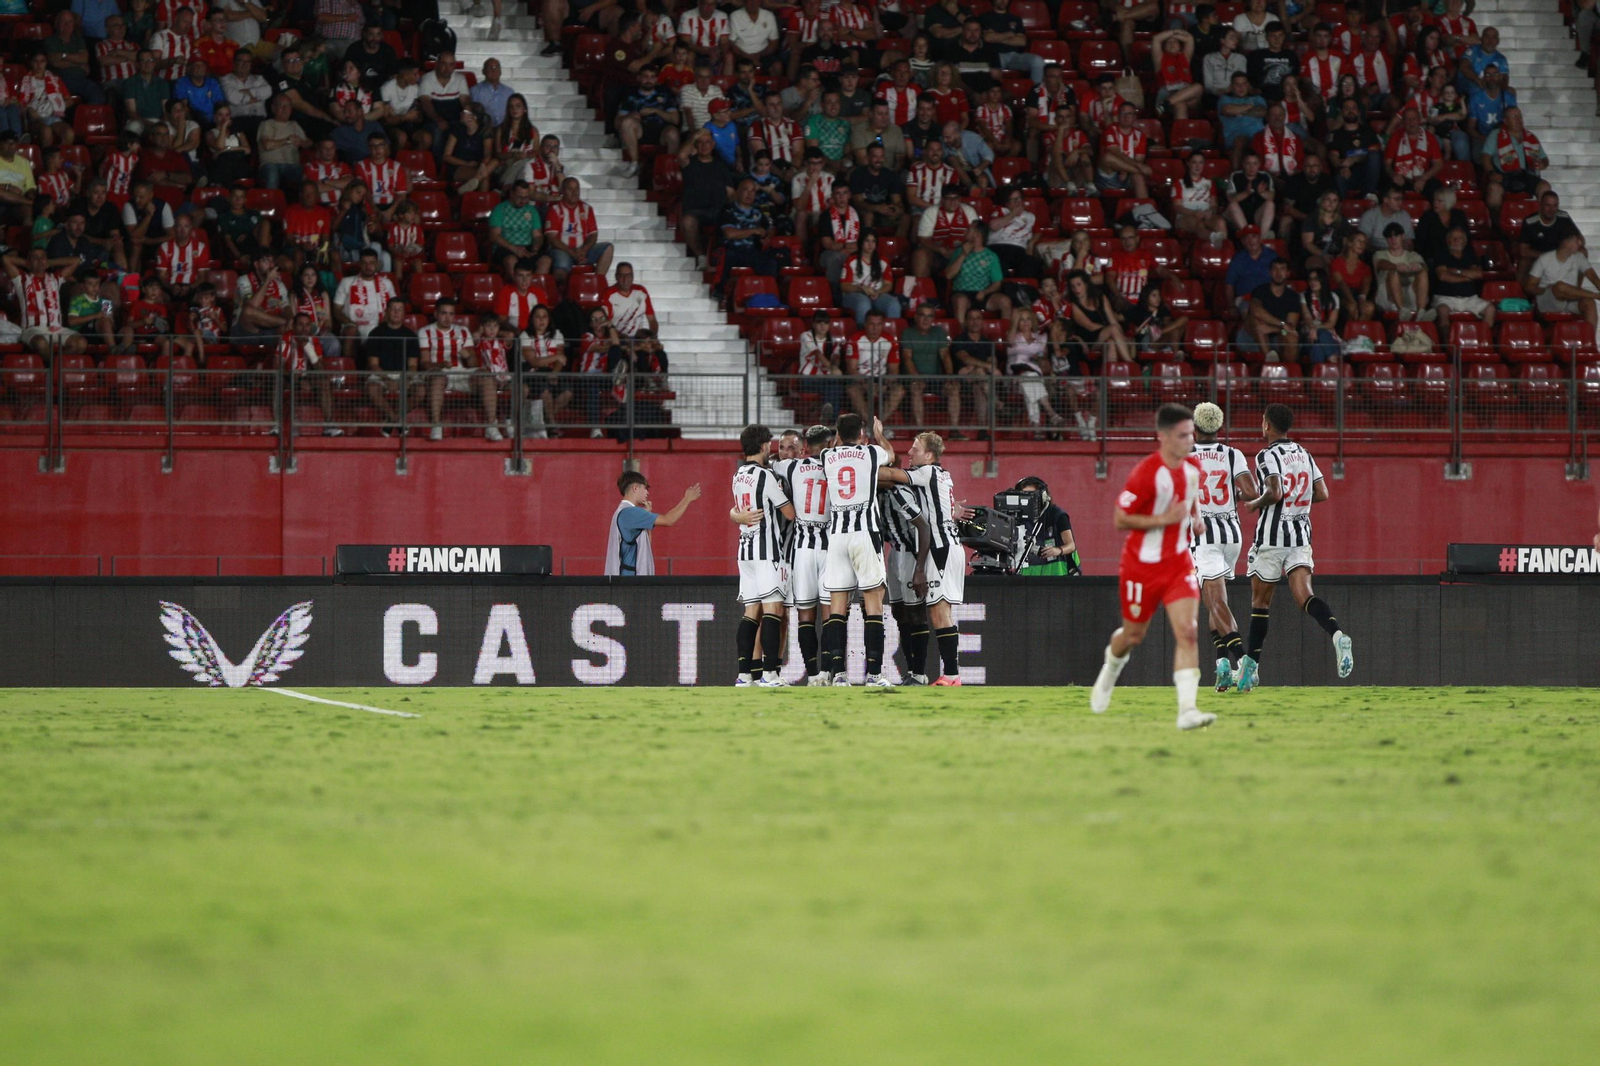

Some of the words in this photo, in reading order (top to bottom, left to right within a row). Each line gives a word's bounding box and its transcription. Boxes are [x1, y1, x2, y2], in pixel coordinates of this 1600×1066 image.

[828, 455, 837, 464] DE
[838, 451, 866, 460] MIGUEL
[803, 478, 828, 515] 11
[838, 466, 856, 499] 9
[1199, 470, 1229, 505] 33
[1284, 472, 1310, 507] 22
[388, 547, 501, 572] #FANCAM
[1126, 580, 1142, 603] 11
